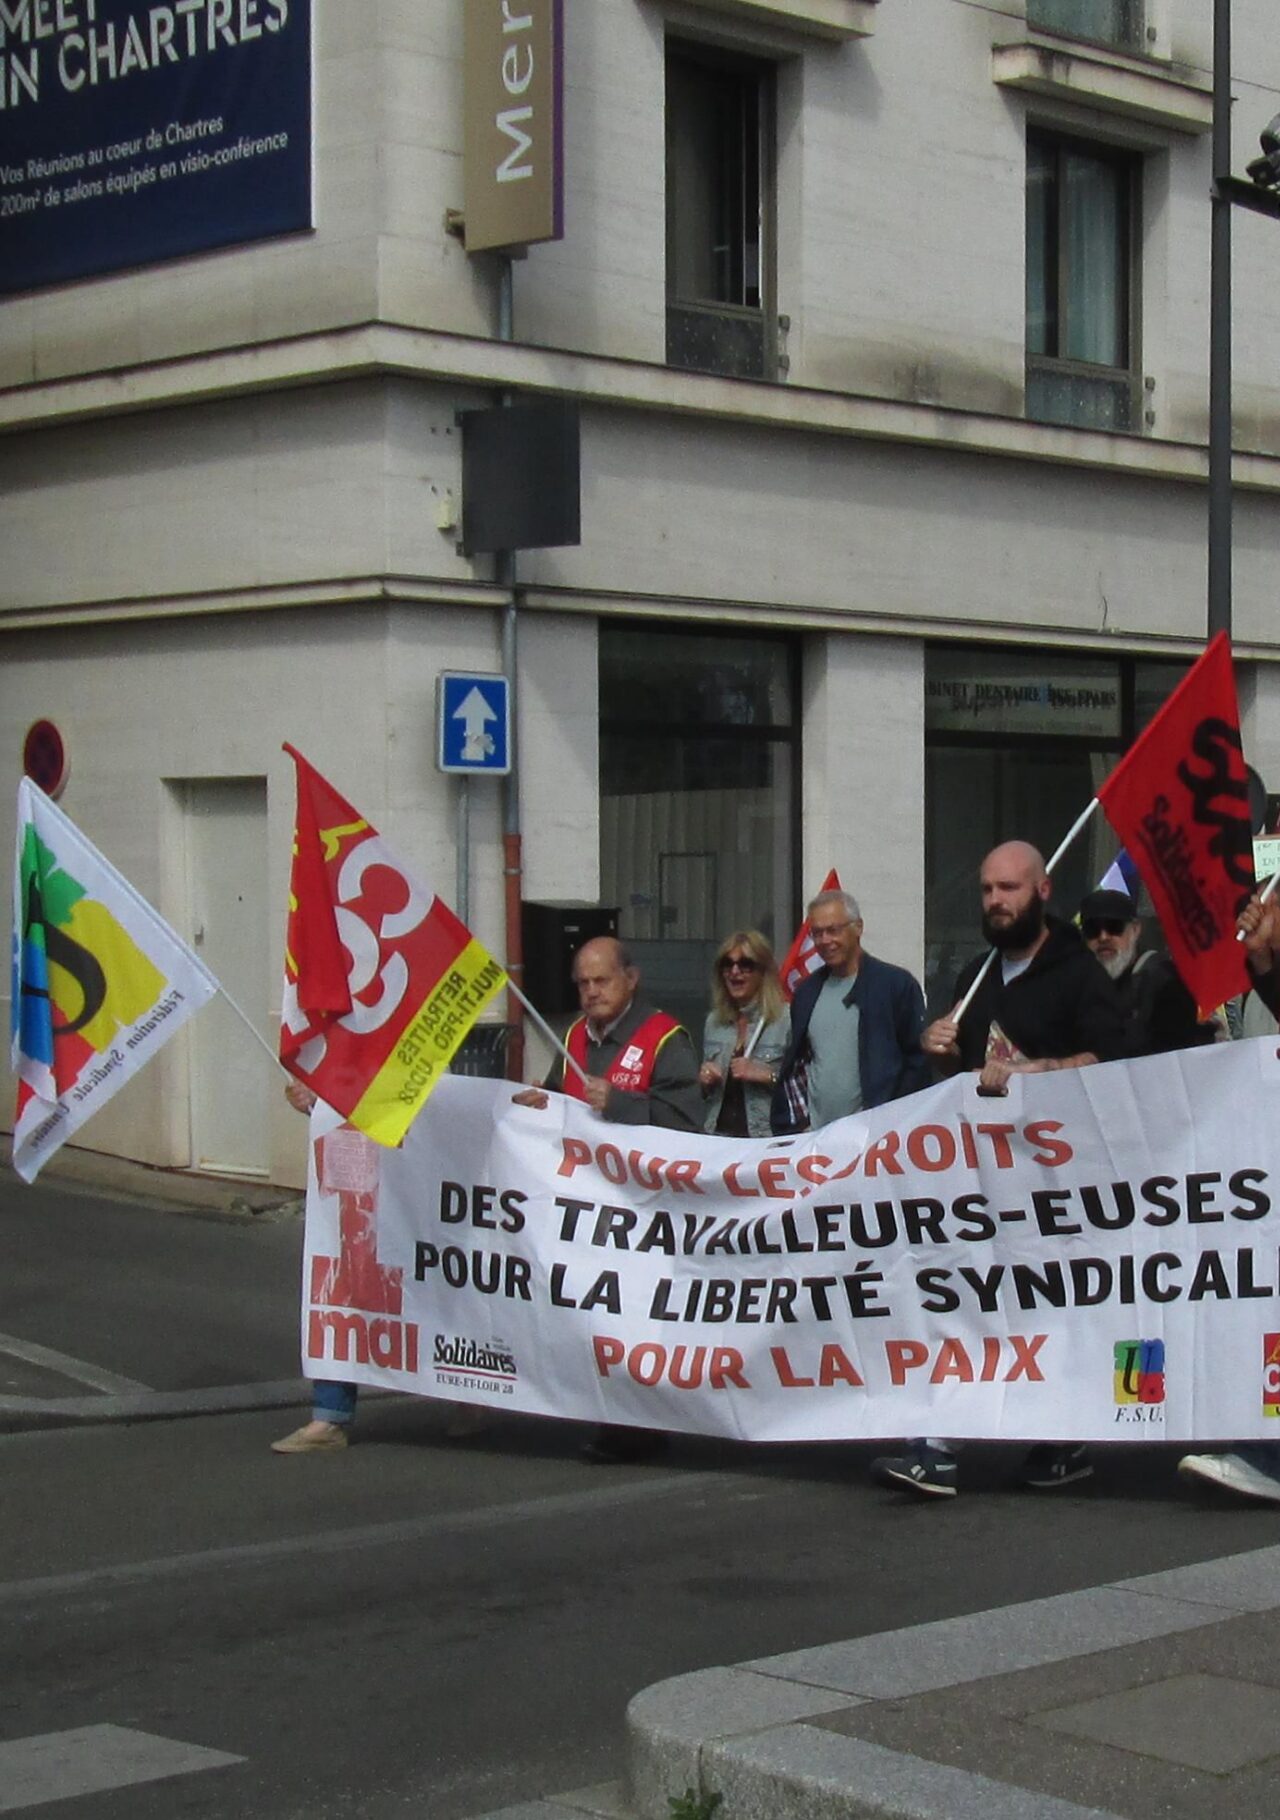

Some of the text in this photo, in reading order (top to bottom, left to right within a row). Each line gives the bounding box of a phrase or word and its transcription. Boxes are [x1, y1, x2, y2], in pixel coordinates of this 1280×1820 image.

[59, 0, 288, 92] CHARTRES
[496, 0, 533, 183] Mer
[0, 116, 223, 184] Vos Réunions au coeur de Chartres
[44, 185, 61, 207] de
[64, 178, 102, 203] salons
[106, 162, 157, 194] équipés
[159, 161, 177, 179] en
[180, 131, 288, 174] visio-conférence
[556, 1137, 705, 1195] POUR
[838, 1119, 1074, 1181] ROITS
[439, 1168, 1272, 1257] DES TRAVAILLEURS-EUSES
[414, 1240, 533, 1302] POUR
[549, 1262, 622, 1316] LA
[648, 1259, 891, 1323] LIBERTÉ
[308, 1309, 420, 1374] mai
[433, 1333, 517, 1375] Solidaires
[592, 1334, 1049, 1391] POUR LA PAIX
[1115, 1406, 1163, 1422] F.S.U.
